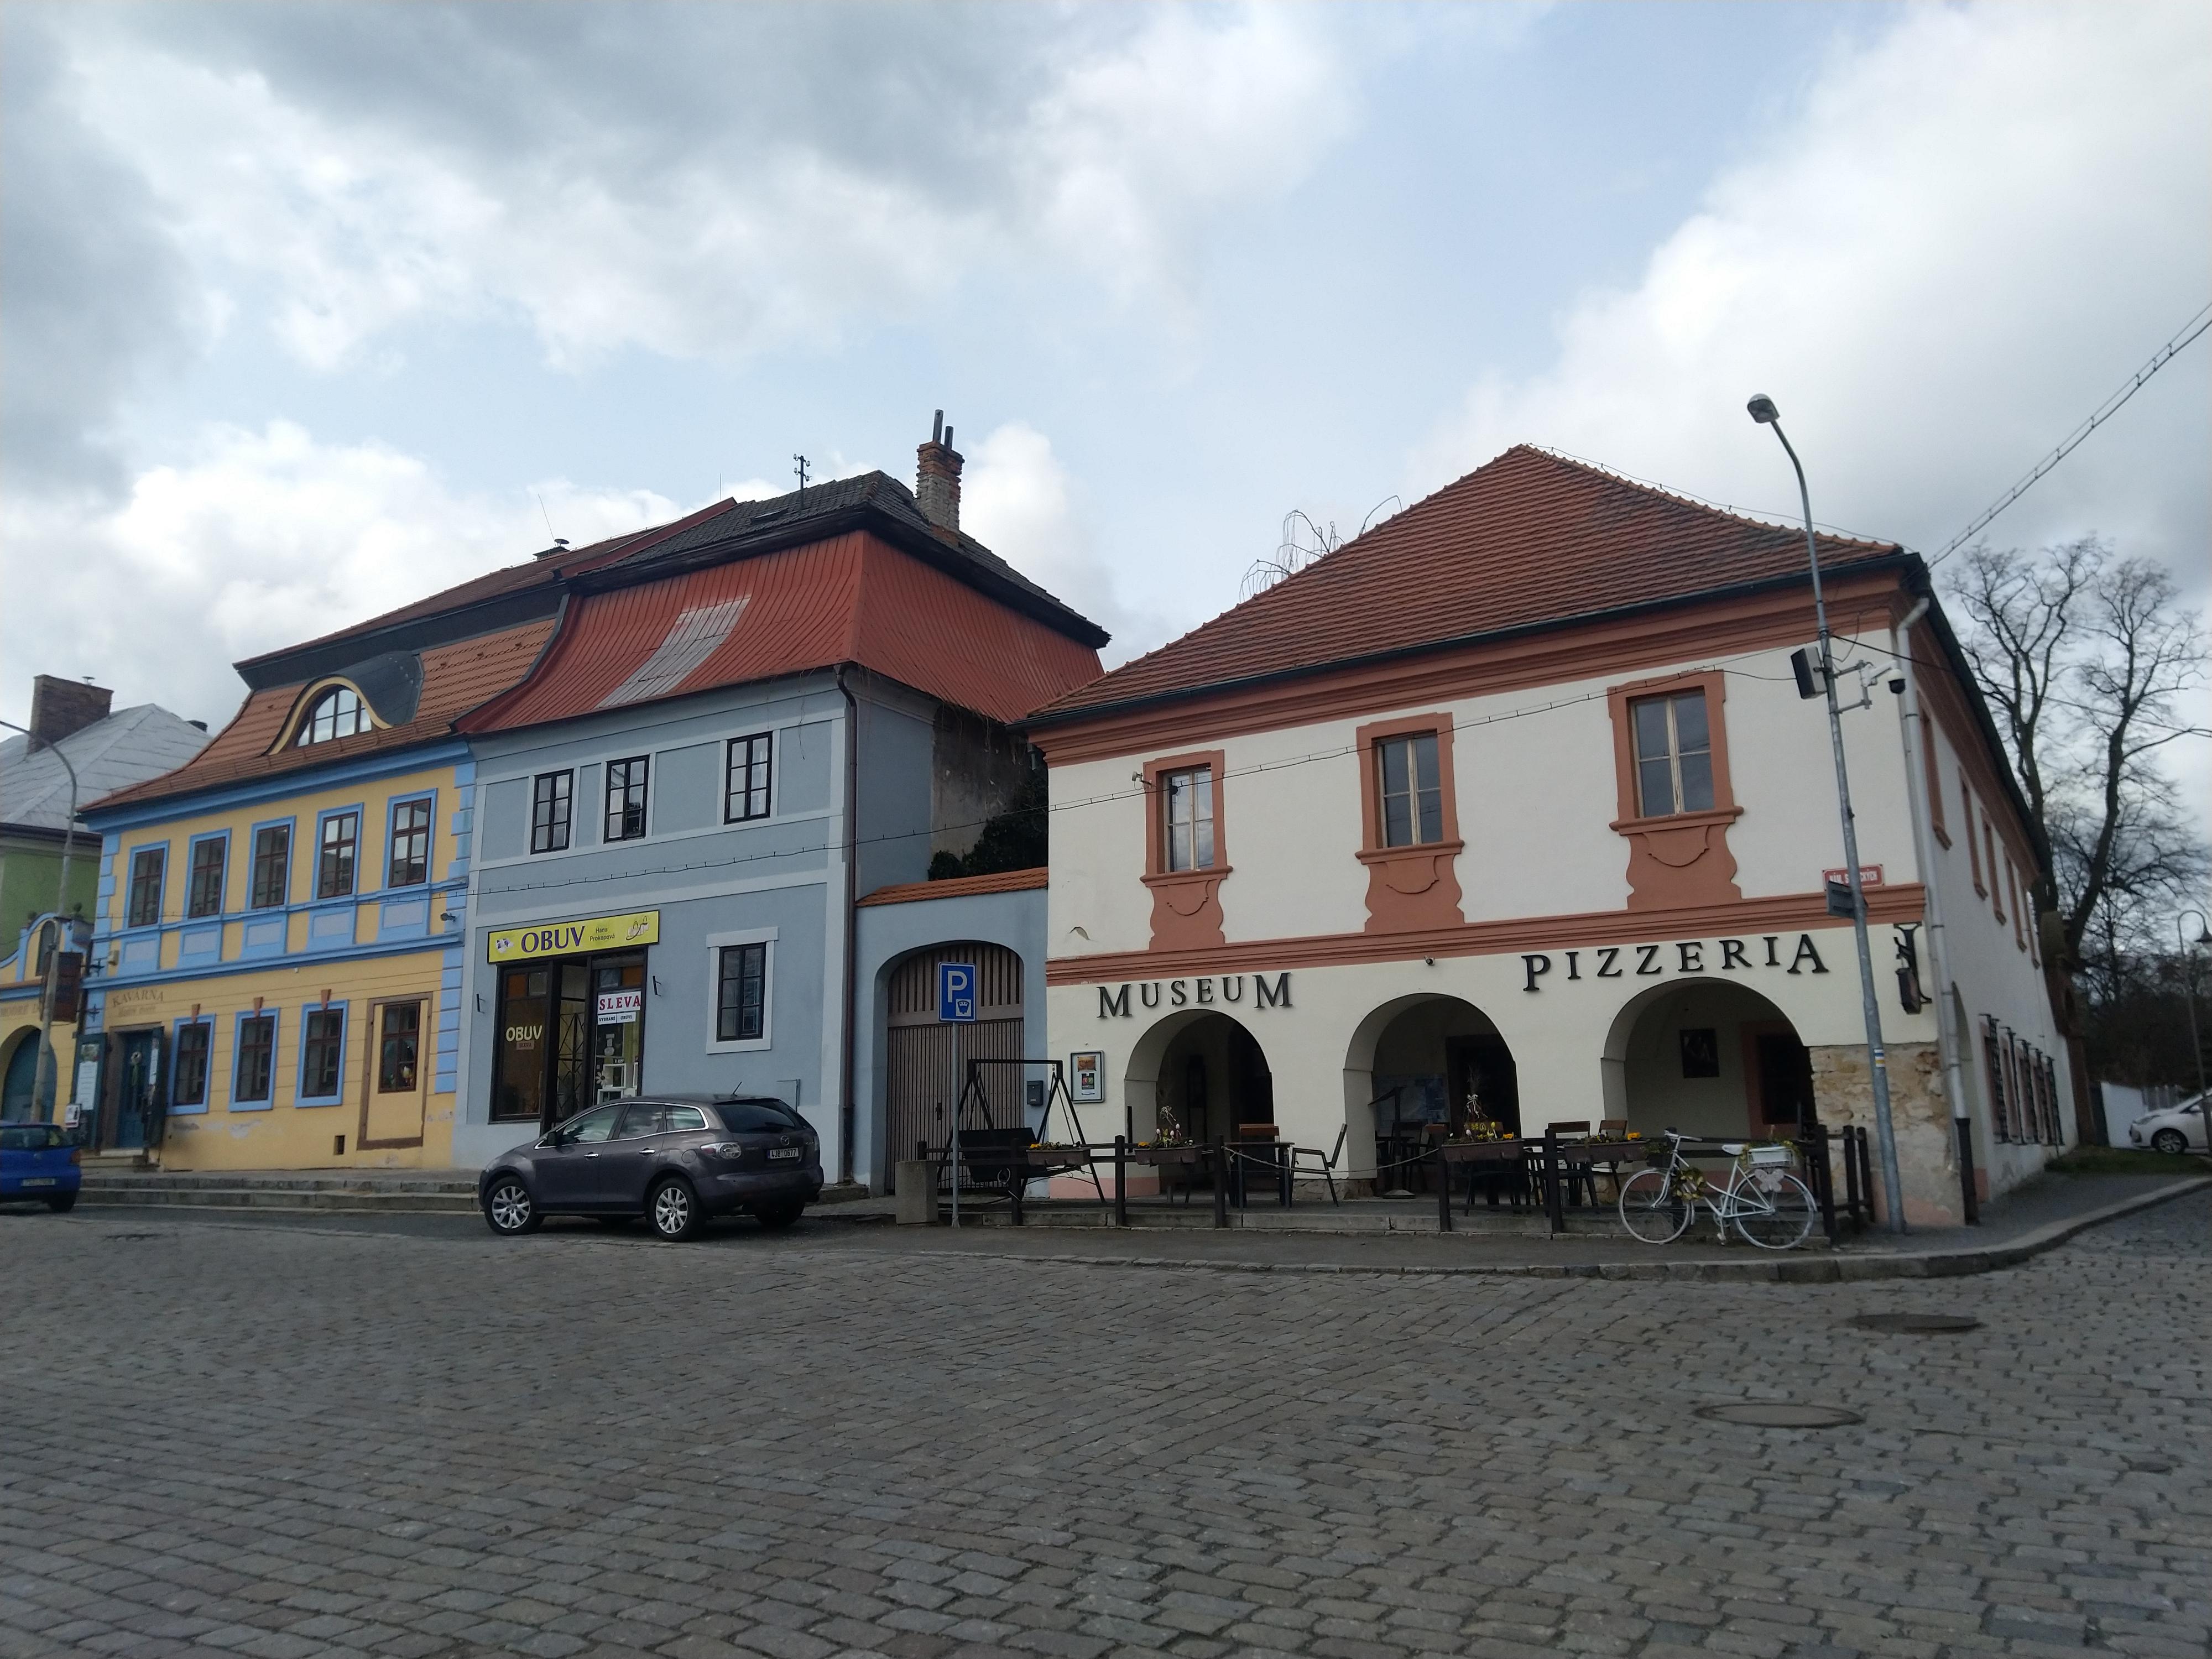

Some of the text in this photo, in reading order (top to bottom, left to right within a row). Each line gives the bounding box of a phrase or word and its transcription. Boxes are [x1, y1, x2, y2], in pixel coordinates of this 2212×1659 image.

[521, 926, 585, 953] OBUV
[589, 933, 615, 942] Prokopová
[1521, 933, 1829, 992] PIZZERIA
[947, 971, 968, 1003] P
[1096, 972, 1293, 1019] MUSEUM
[599, 995, 641, 1011] SLEVA
[506, 1025, 542, 1042] OBUV
